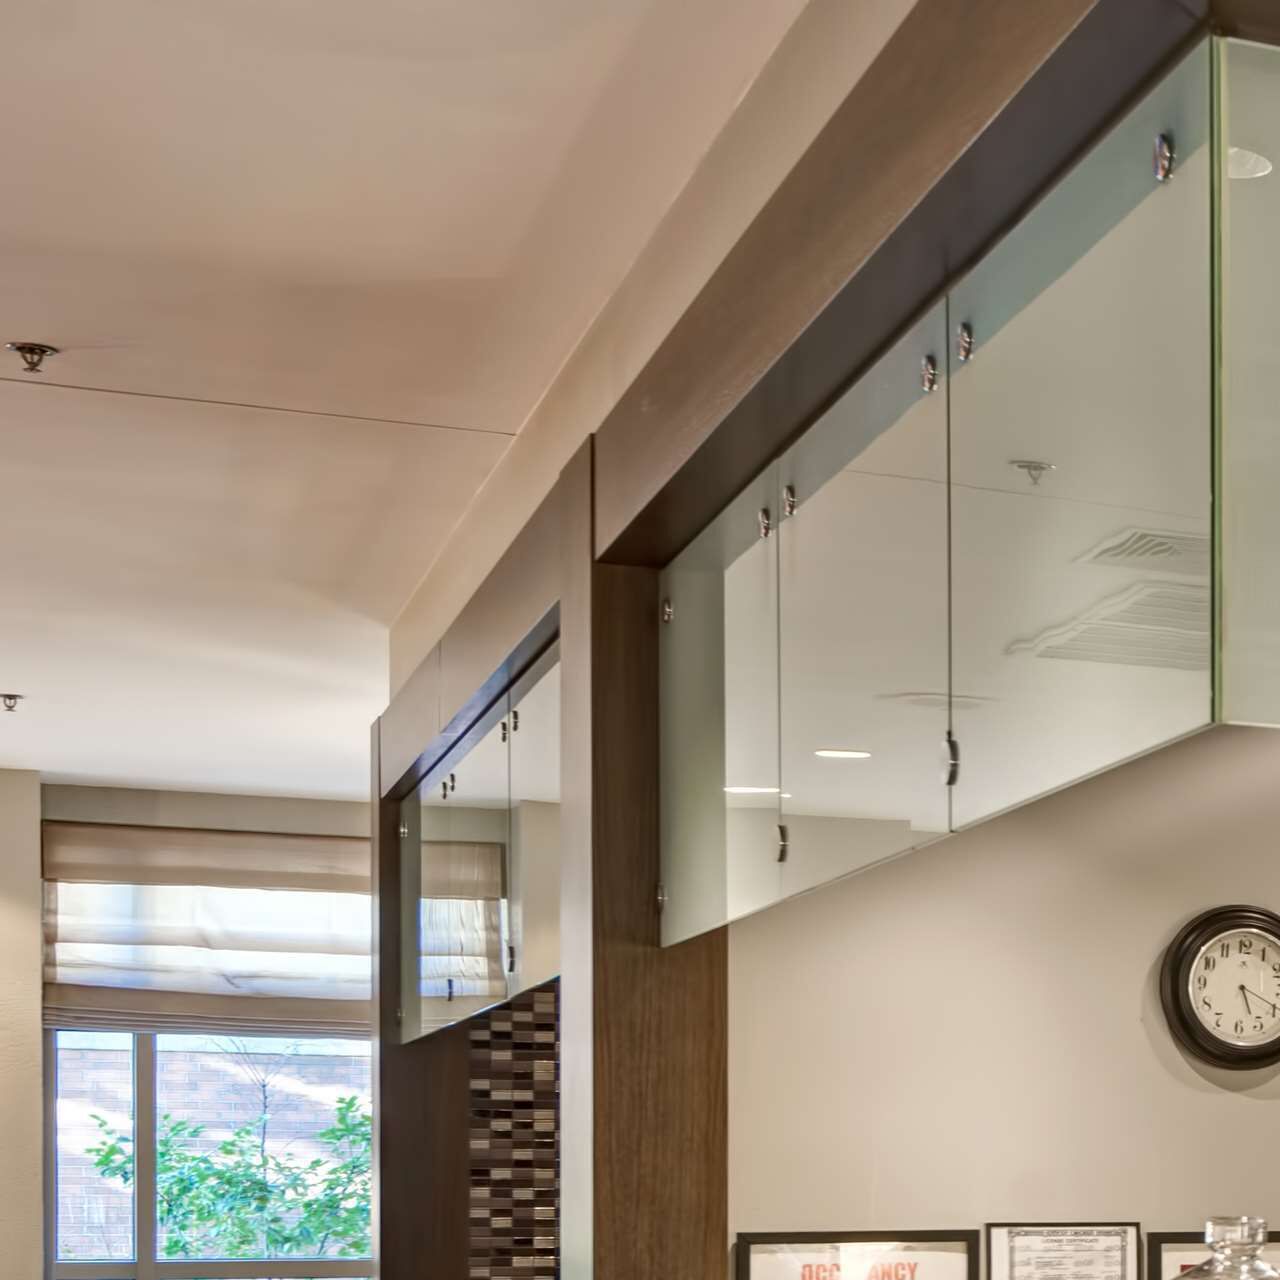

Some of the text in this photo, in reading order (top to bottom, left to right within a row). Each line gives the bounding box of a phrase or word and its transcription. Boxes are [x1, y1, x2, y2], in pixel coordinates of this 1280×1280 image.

[1220, 942, 1230, 958] 11
[1239, 938, 1253, 954] 12
[1204, 956, 1216, 971] 10
[1197, 975, 1207, 991] 9
[1201, 996, 1212, 1011] 8
[1214, 1012, 1223, 1028] 7
[1234, 1020, 1244, 1035] 6
[1253, 1015, 1264, 1032] 5
